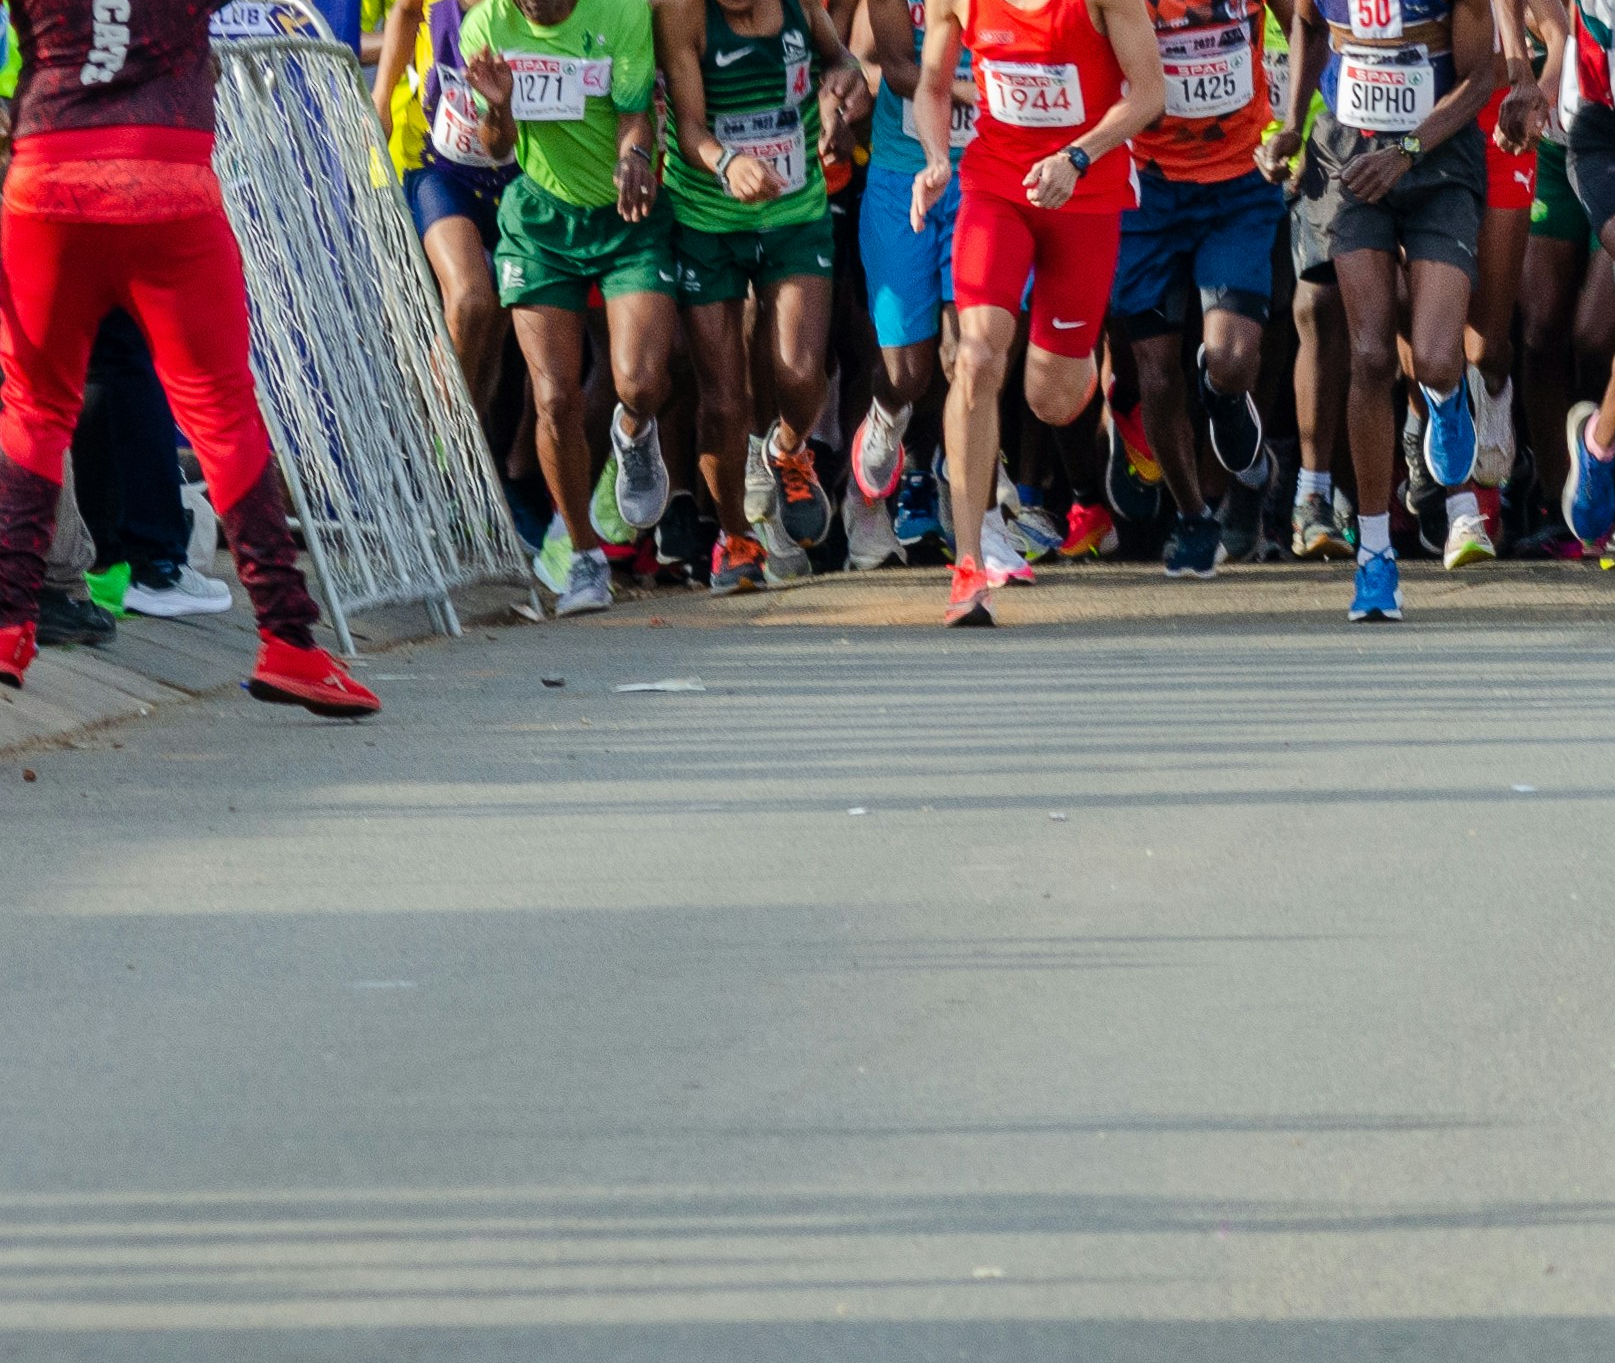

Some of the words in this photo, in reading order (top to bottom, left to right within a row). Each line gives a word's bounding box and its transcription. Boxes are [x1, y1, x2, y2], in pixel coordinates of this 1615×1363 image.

[211, 7, 260, 27] LUB
[1177, 61, 1228, 76] SPAR
[1355, 69, 1405, 85] SPAR
[519, 74, 563, 103] 1271
[996, 83, 1072, 113] 1944
[1181, 73, 1236, 103] 1425
[1351, 83, 1416, 114] SIPHO
